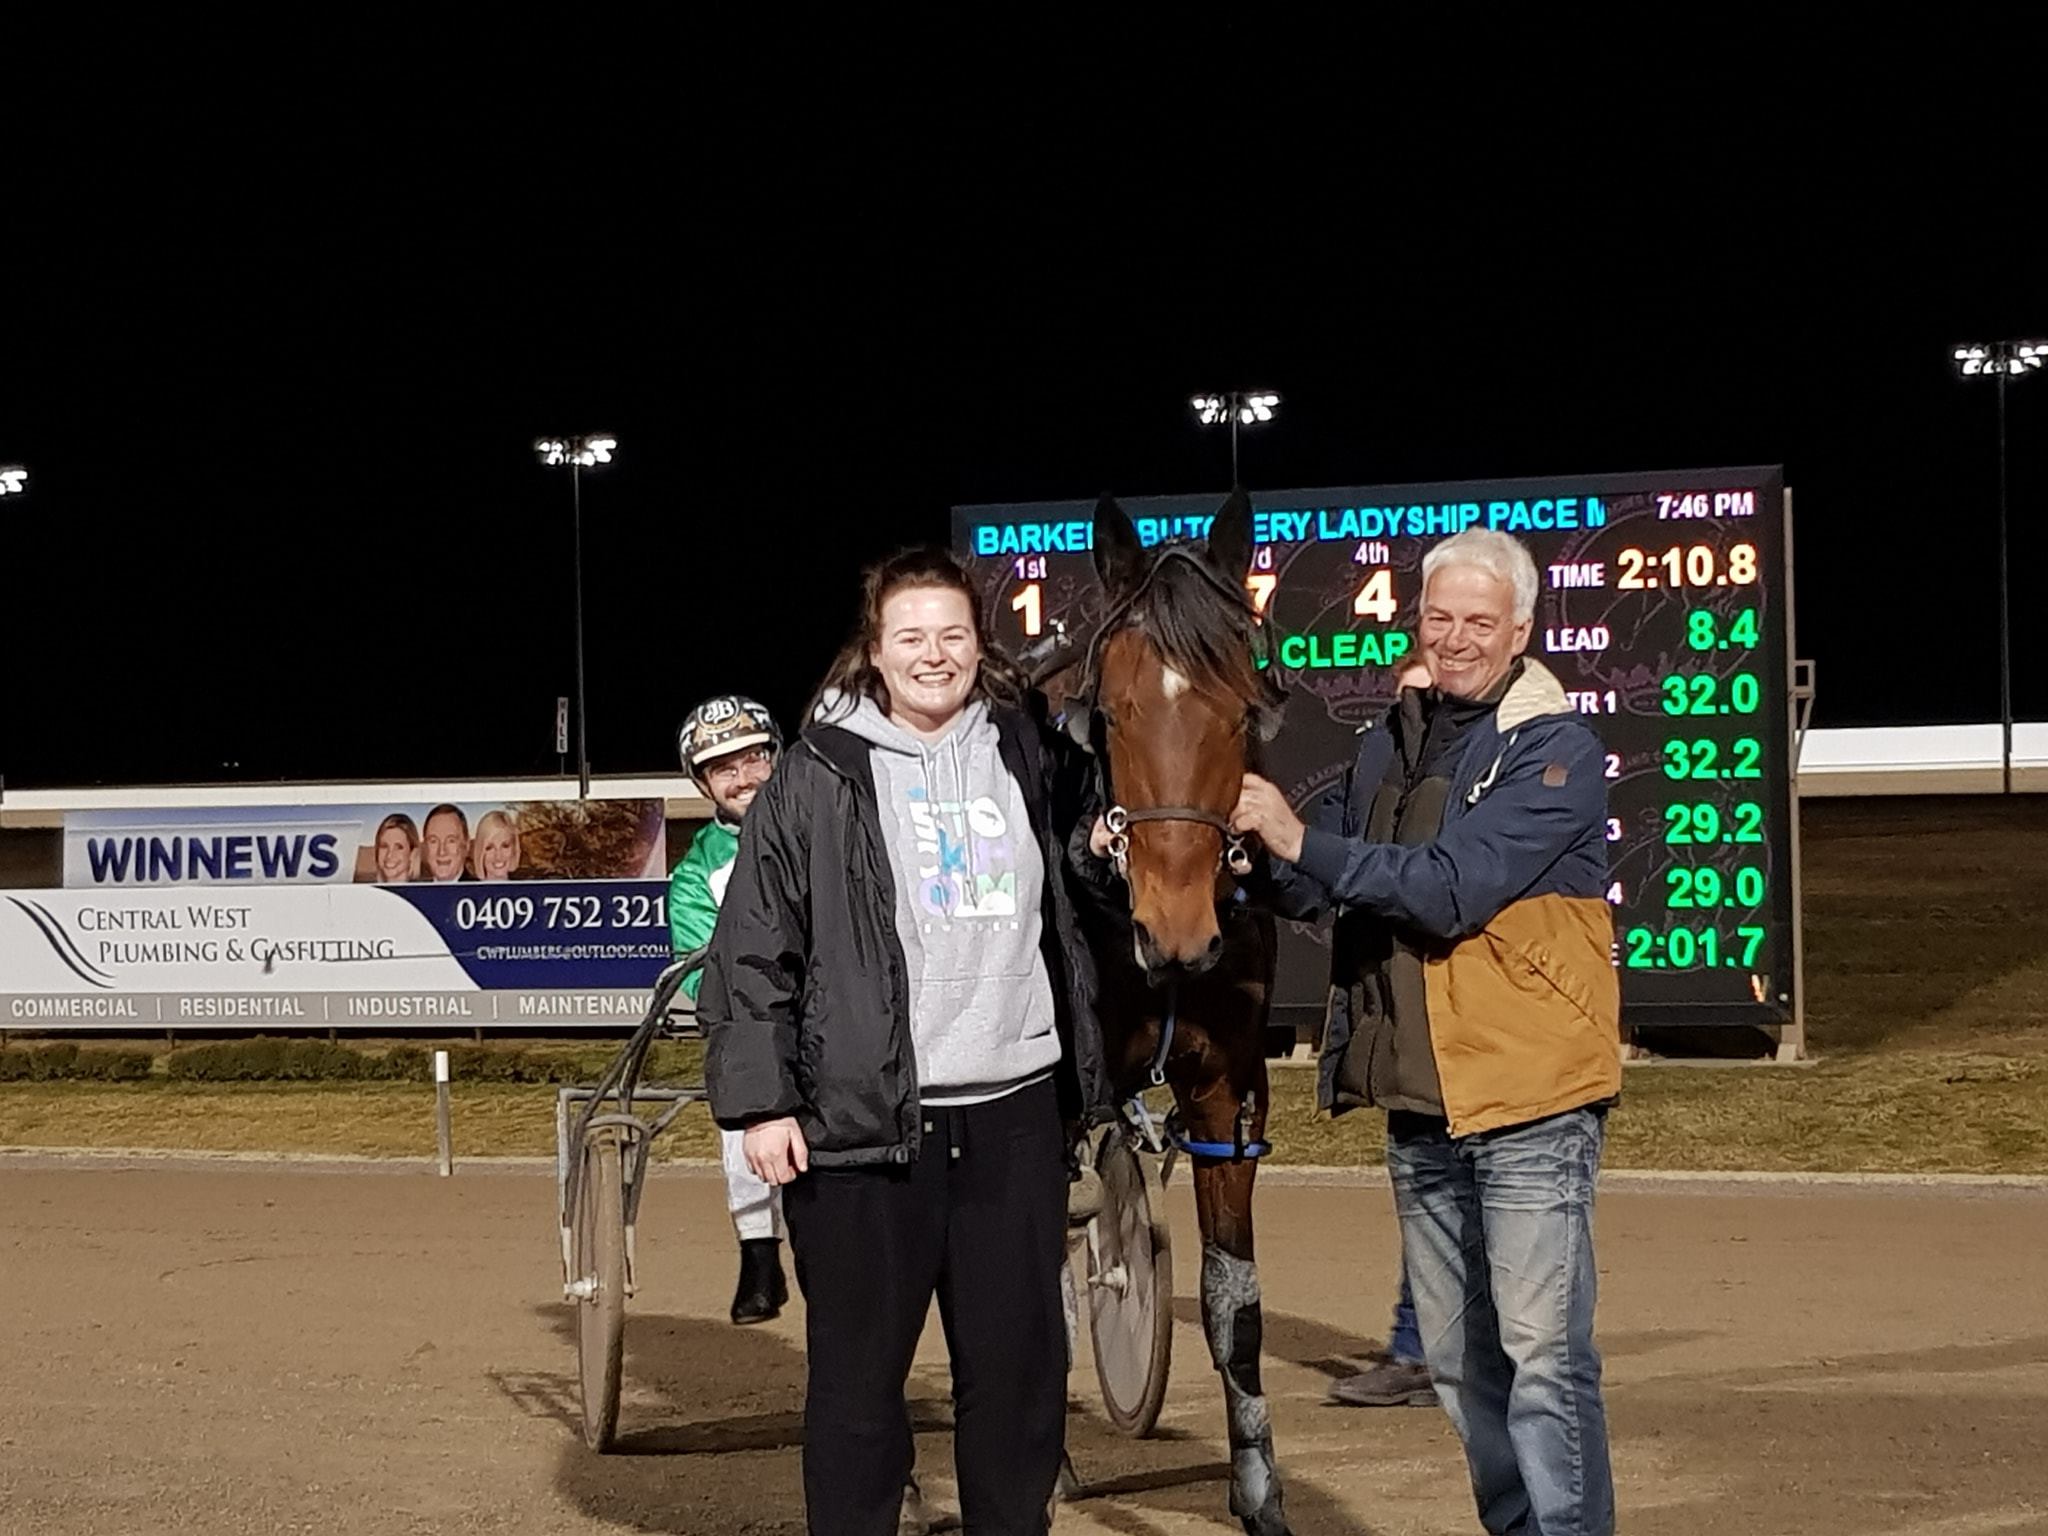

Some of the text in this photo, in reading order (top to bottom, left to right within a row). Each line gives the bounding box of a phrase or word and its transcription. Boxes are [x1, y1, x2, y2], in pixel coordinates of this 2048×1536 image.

[1319, 503, 1480, 540] LADYSHIP
[1489, 498, 1578, 532] PACE
[1657, 492, 1754, 520] 7:46 PM
[1015, 556, 1048, 579] 1st
[1355, 543, 1389, 565] 4th
[1549, 543, 1757, 590] TIME 2:10.8
[1012, 583, 1041, 636] 1
[1246, 574, 1277, 626] 7
[1354, 569, 1398, 623] 4
[1546, 608, 1759, 653] LEAD 8.4
[1566, 673, 1760, 716] TR 1 32.0
[1605, 753, 1621, 778] 2
[1663, 737, 1762, 780] 32.2
[1606, 802, 1763, 845] 3 29.2
[1607, 866, 1764, 908] 4 29.0
[77, 906, 252, 931] CENTRAL WEST
[456, 895, 669, 930] 0409 752 321
[99, 939, 394, 964] PLUMBING & GASFITTING
[1626, 926, 1766, 968] 2:01.7
[11, 999, 138, 1018] COMMERCIAL
[180, 997, 305, 1017] RESIDENTIAL
[348, 997, 472, 1016] INDUSTRIAL
